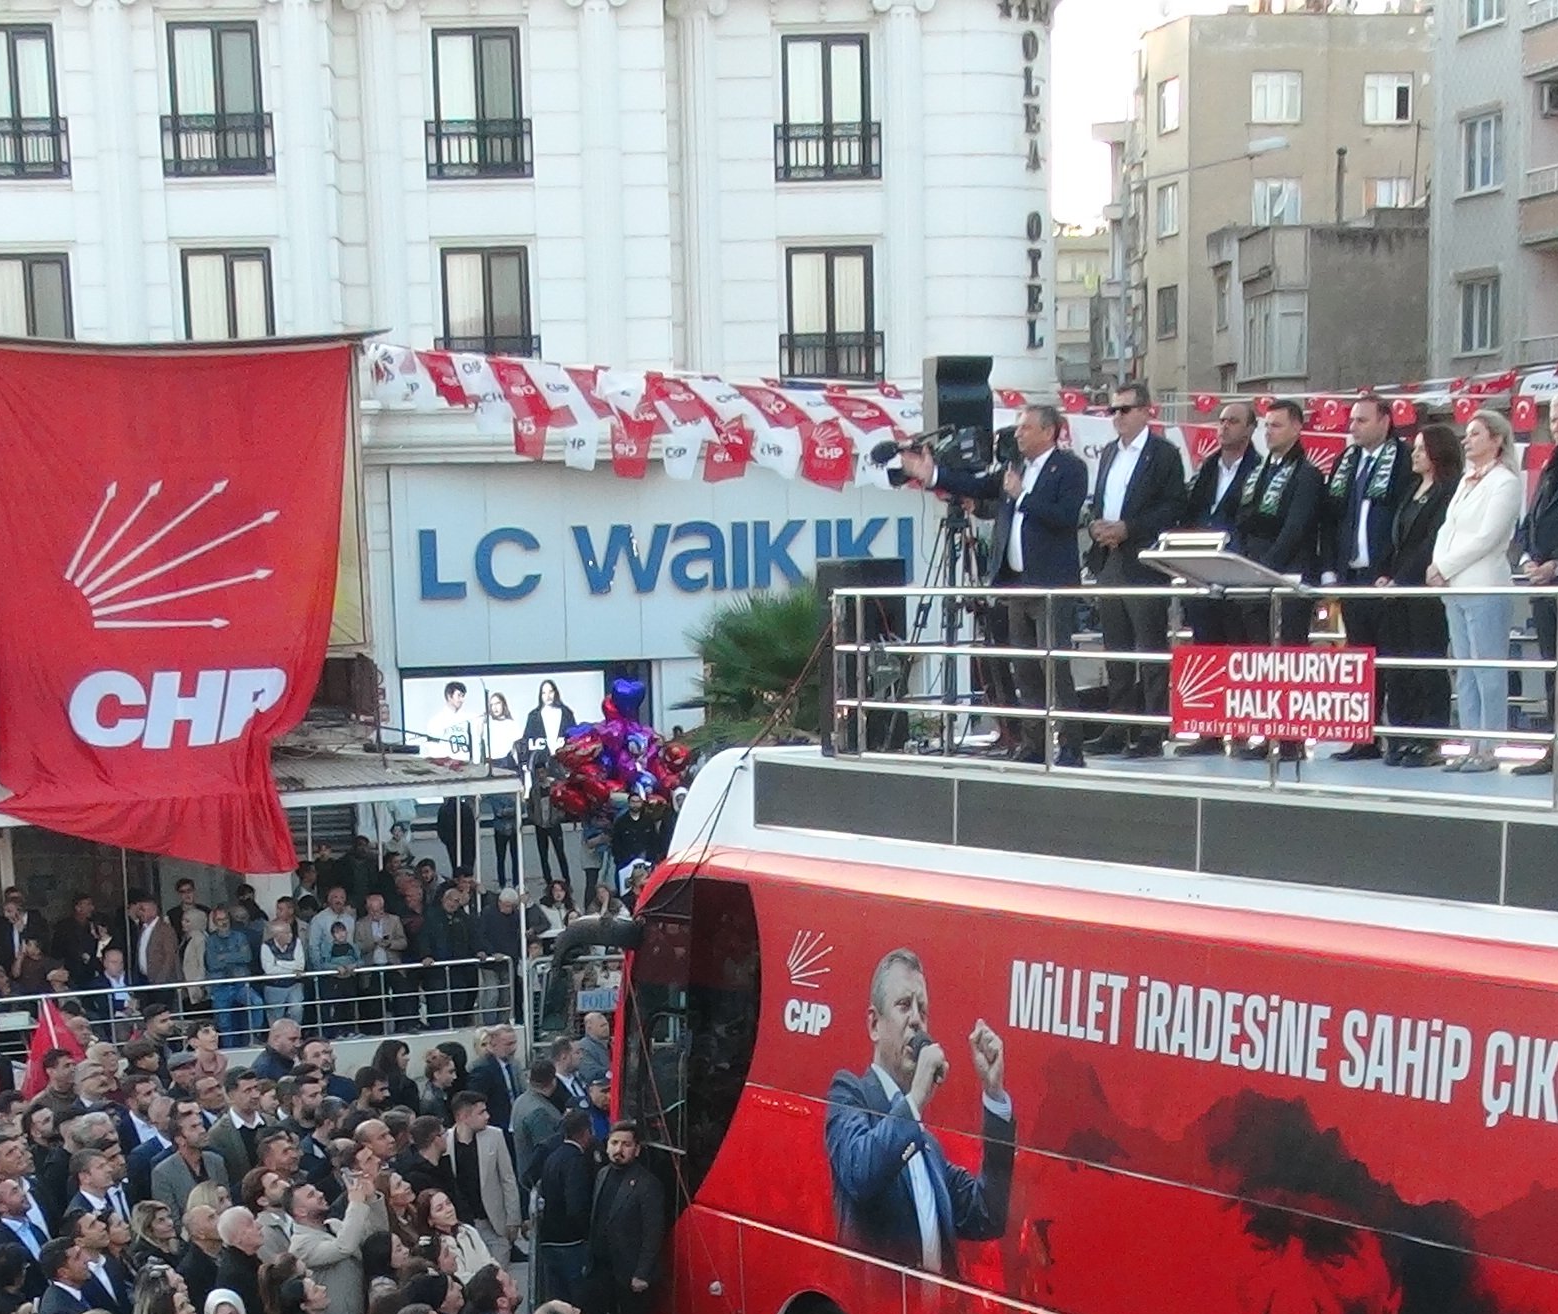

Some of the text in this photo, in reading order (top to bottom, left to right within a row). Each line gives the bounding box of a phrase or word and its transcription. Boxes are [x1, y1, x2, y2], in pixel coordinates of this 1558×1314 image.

[418, 527, 543, 601] LC
[1228, 652, 1369, 684] CUMHURİYET
[70, 667, 287, 752] CHP
[1226, 689, 1370, 723] HALK PARTİSİ
[784, 997, 831, 1036] CHP
[1009, 959, 1128, 1044] MİLLET
[1134, 978, 1333, 1083] İRADESİNE
[1341, 1010, 1471, 1105] SAHİP
